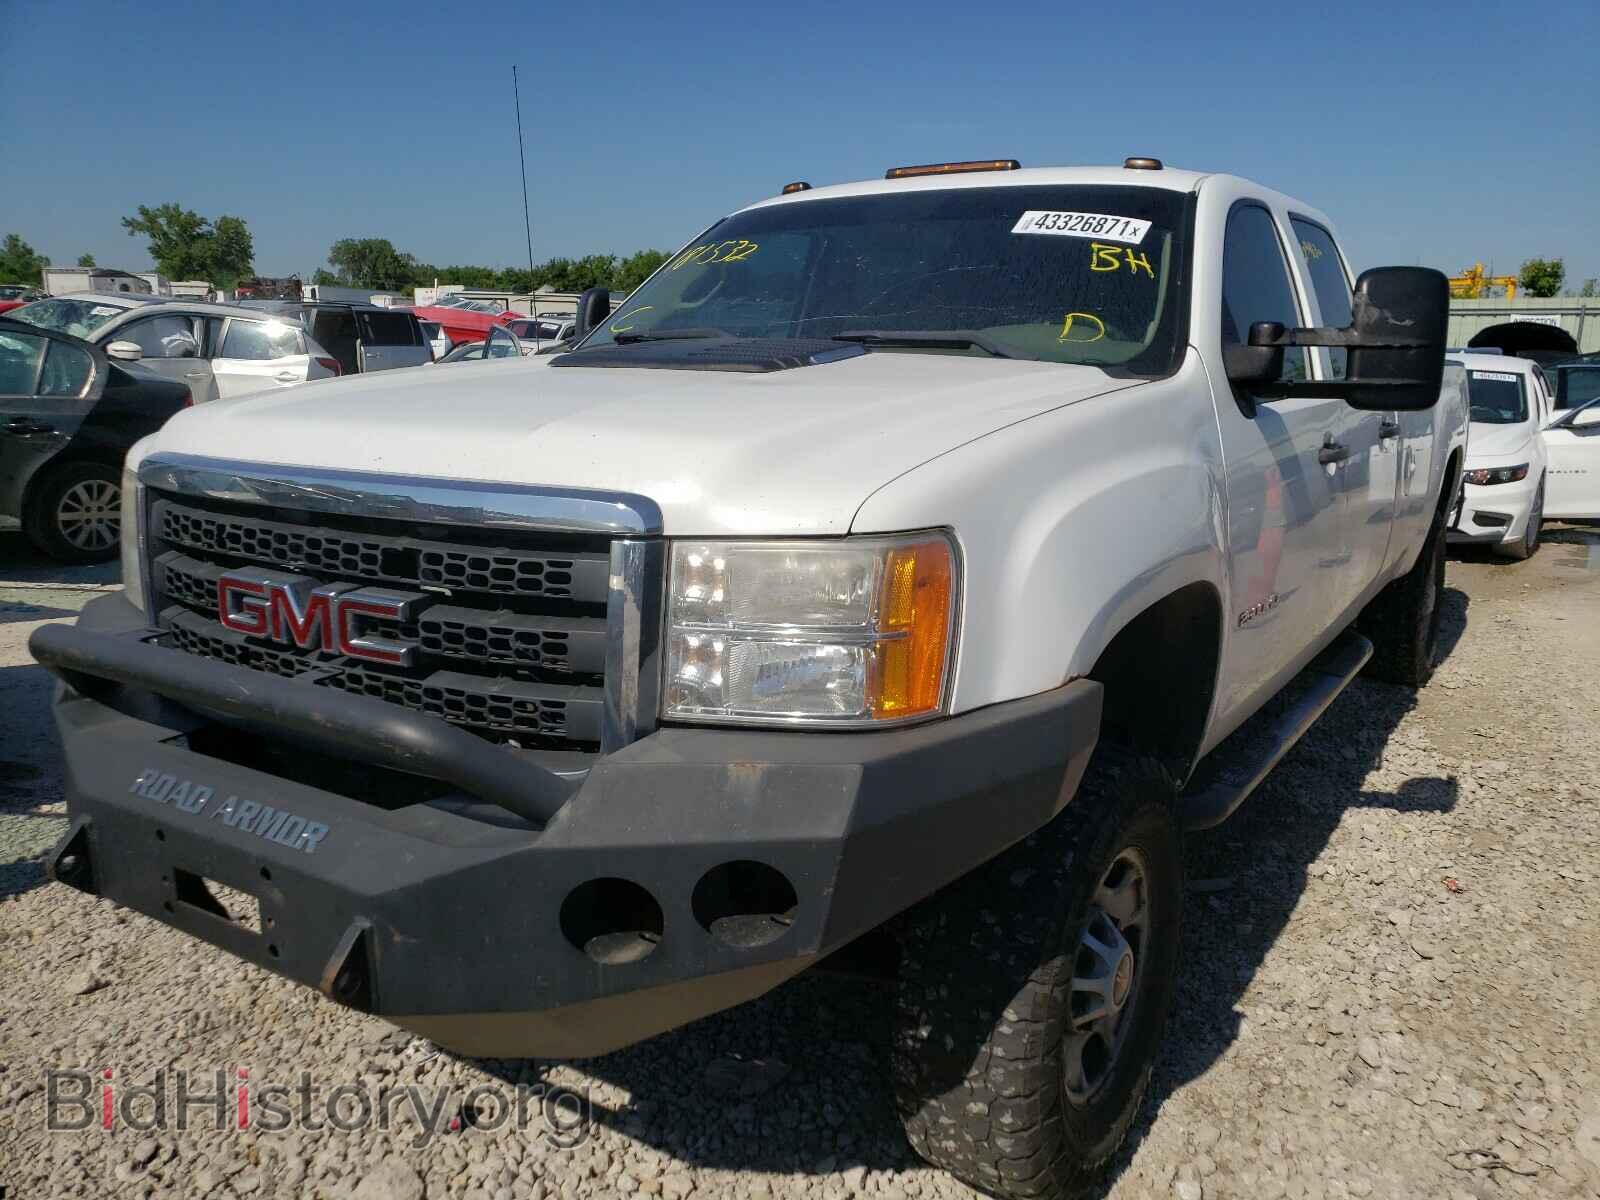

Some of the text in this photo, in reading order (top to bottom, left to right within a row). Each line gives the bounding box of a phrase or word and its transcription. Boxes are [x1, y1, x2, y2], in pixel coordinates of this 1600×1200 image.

[1090, 242, 1155, 279] BH
[1057, 312, 1105, 343] D
[217, 573, 412, 667] GMC
[129, 768, 330, 853] ROAD ARMOR
